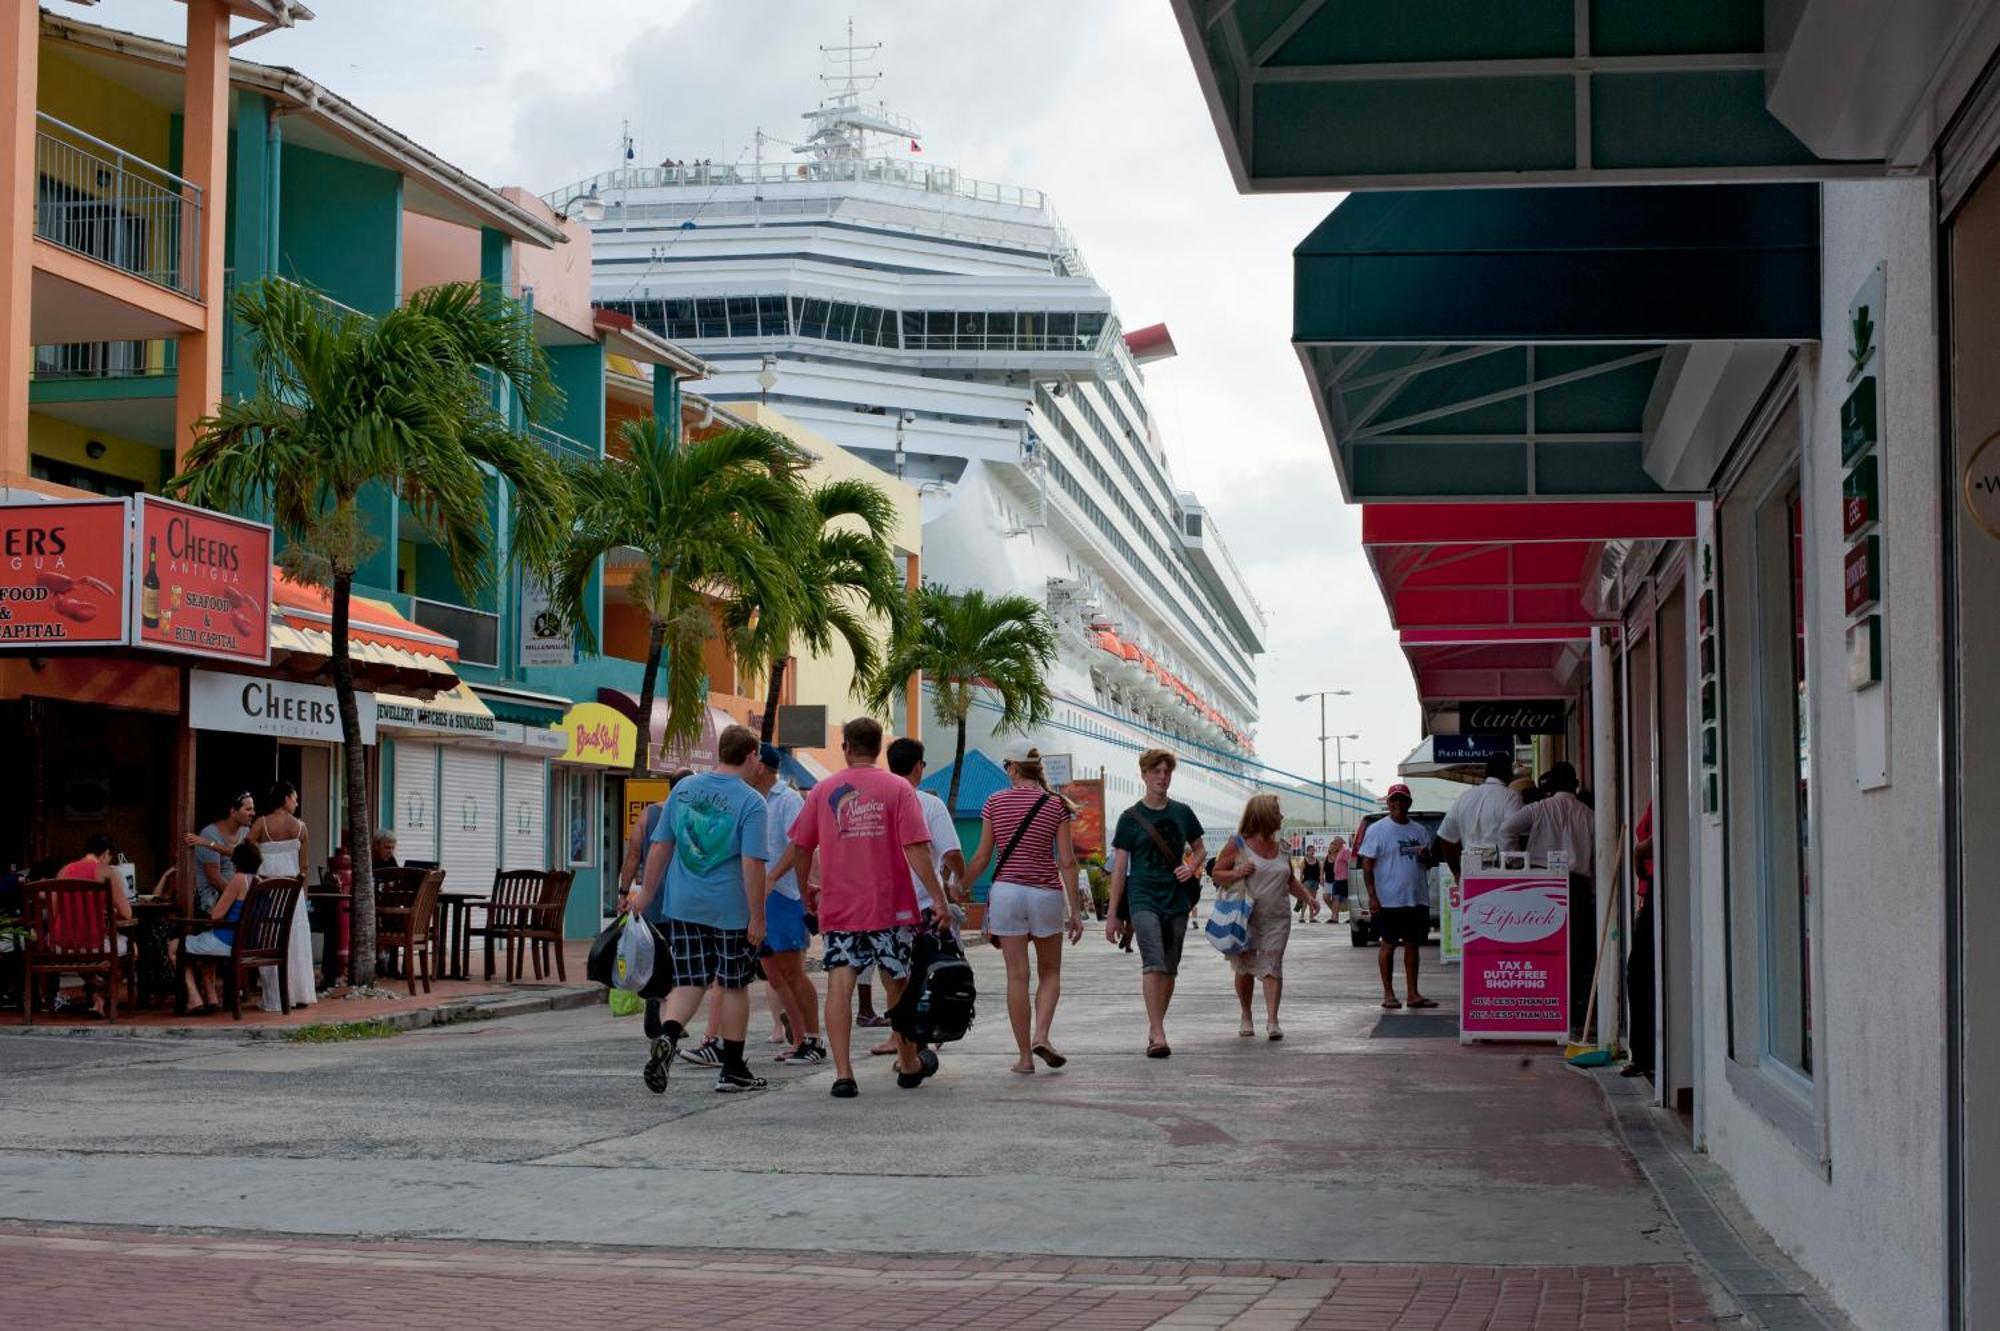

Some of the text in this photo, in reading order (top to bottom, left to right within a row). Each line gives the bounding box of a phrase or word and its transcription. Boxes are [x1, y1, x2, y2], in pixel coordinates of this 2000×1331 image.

[169, 560, 240, 585] ANTIGUA
[185, 591, 231, 613] SEAFOOD
[203, 614, 212, 627] &
[0, 622, 66, 638] APITAL
[175, 626, 238, 649] RUM CAPITAL
[455, 714, 494, 731] SUNGLASSES
[1470, 705, 1557, 729] Cartier
[1479, 906, 1556, 932] Lipstick
[1497, 961, 1533, 970] TAX &
[1483, 970, 1548, 980] DUTY-FREE
[1486, 980, 1545, 989] SHOPPING
[1517, 997, 1542, 1006] THAN
[1515, 1010, 1541, 1020] THAN
